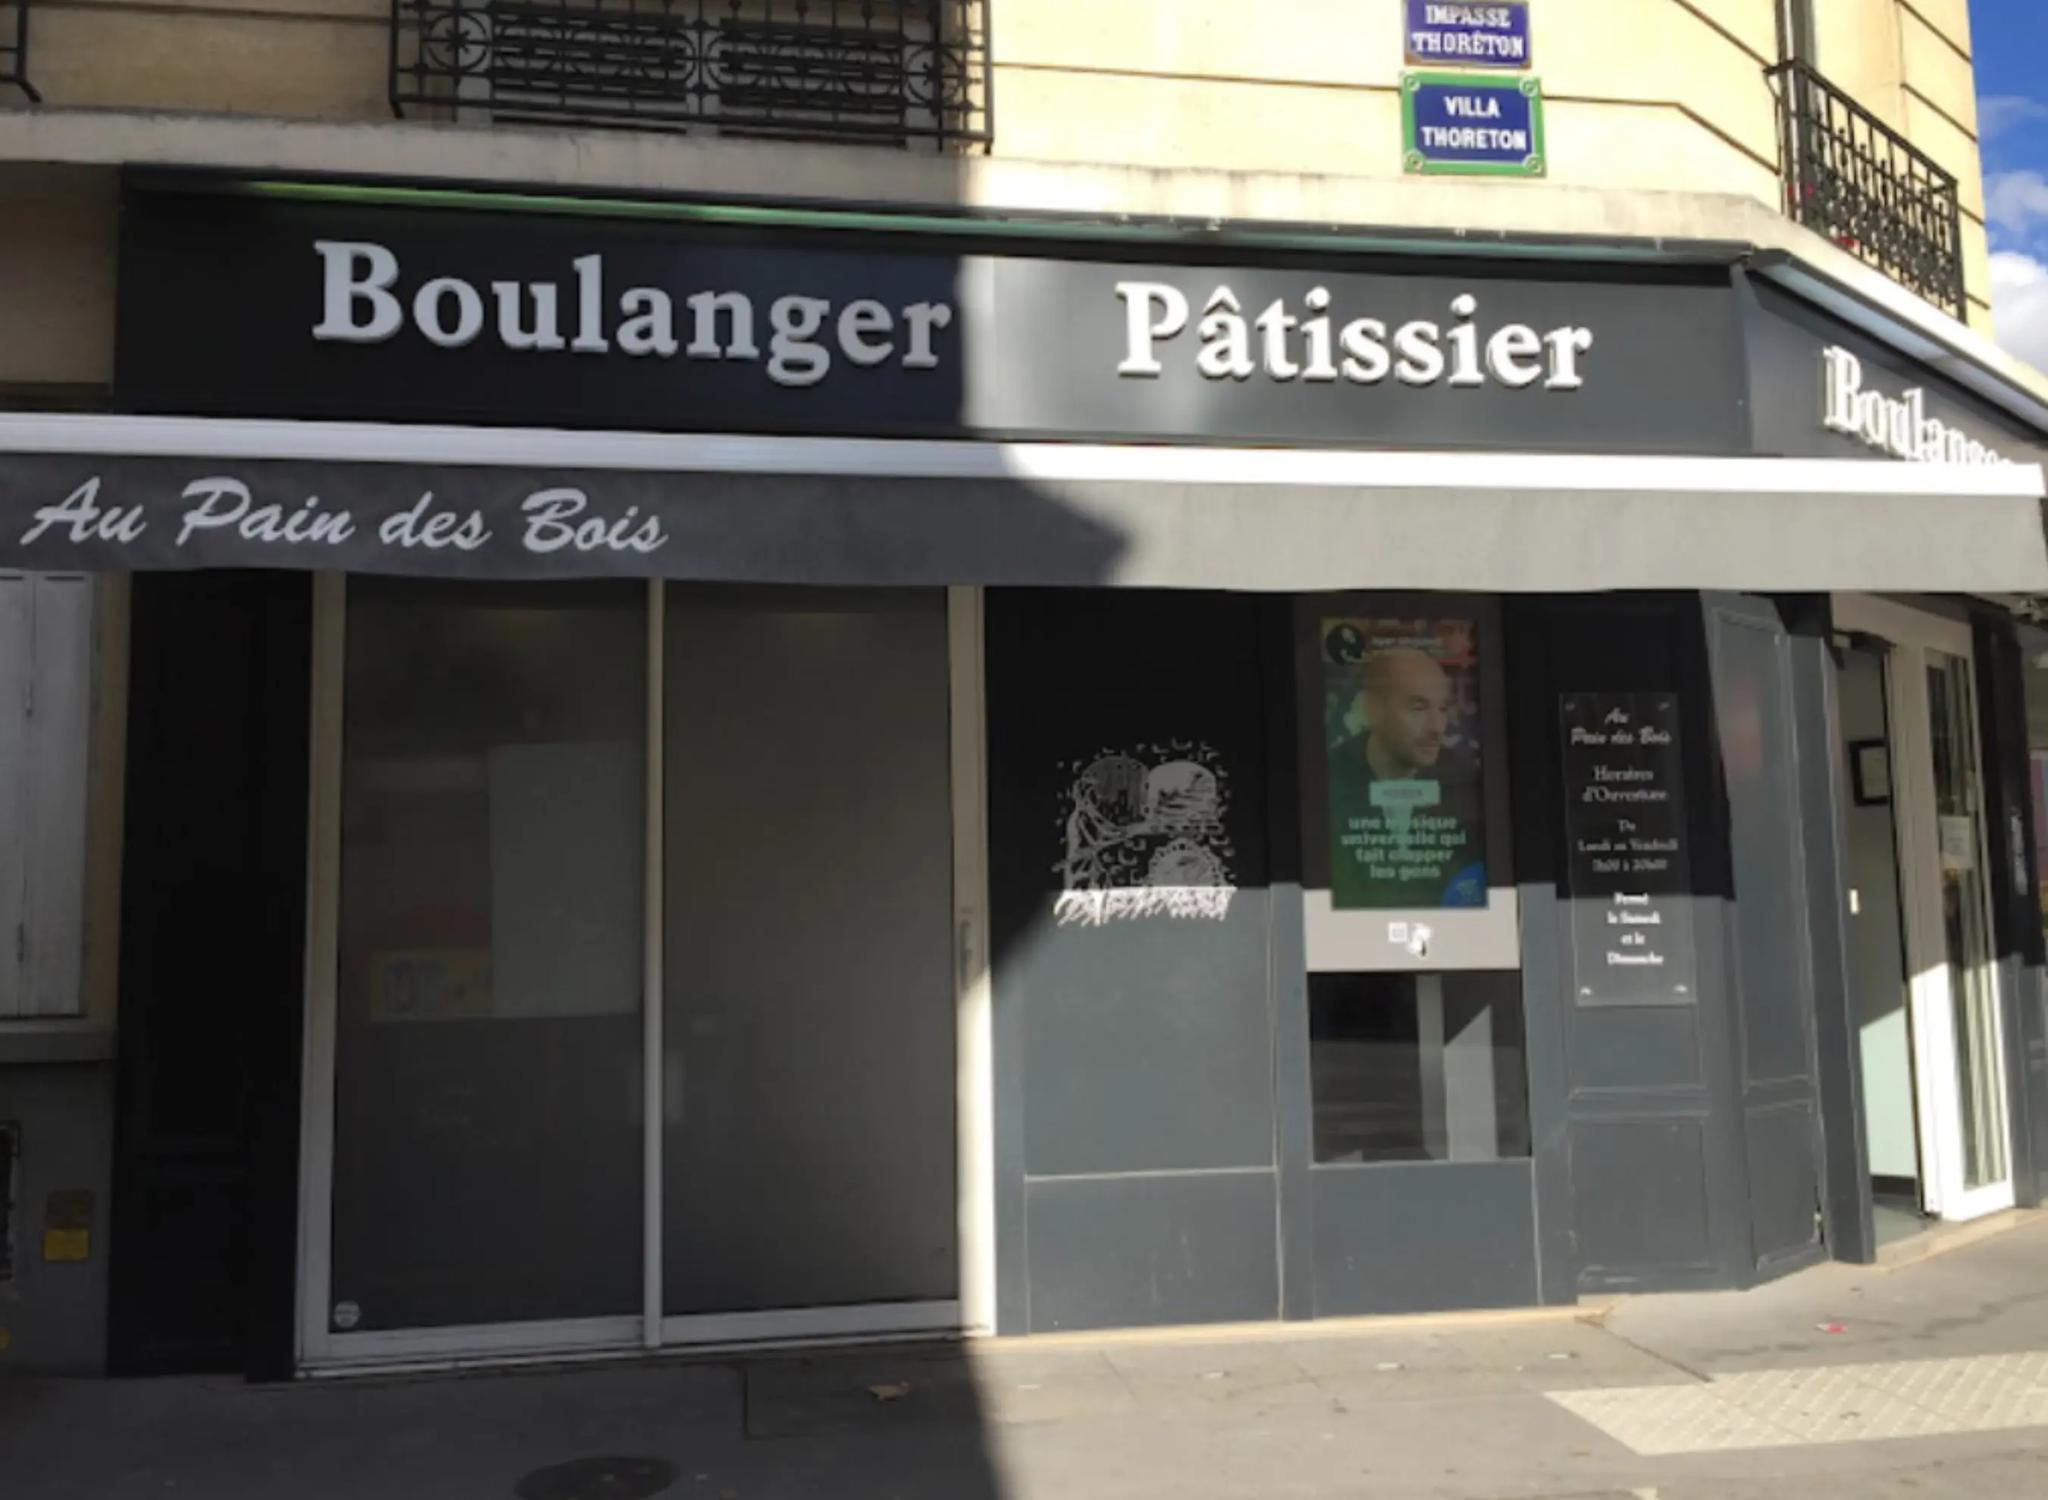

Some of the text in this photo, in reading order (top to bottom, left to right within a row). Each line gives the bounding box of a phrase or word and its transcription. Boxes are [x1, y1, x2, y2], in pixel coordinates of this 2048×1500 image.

[1425, 4, 1512, 28] IMPASSE
[1411, 30, 1524, 58] THORÉTON
[1443, 96, 1502, 118] VILLA
[1421, 125, 1528, 150] THORETON
[312, 239, 1593, 390] Boulanger Pâtissier
[19, 475, 670, 554] Au Pain des Bois
